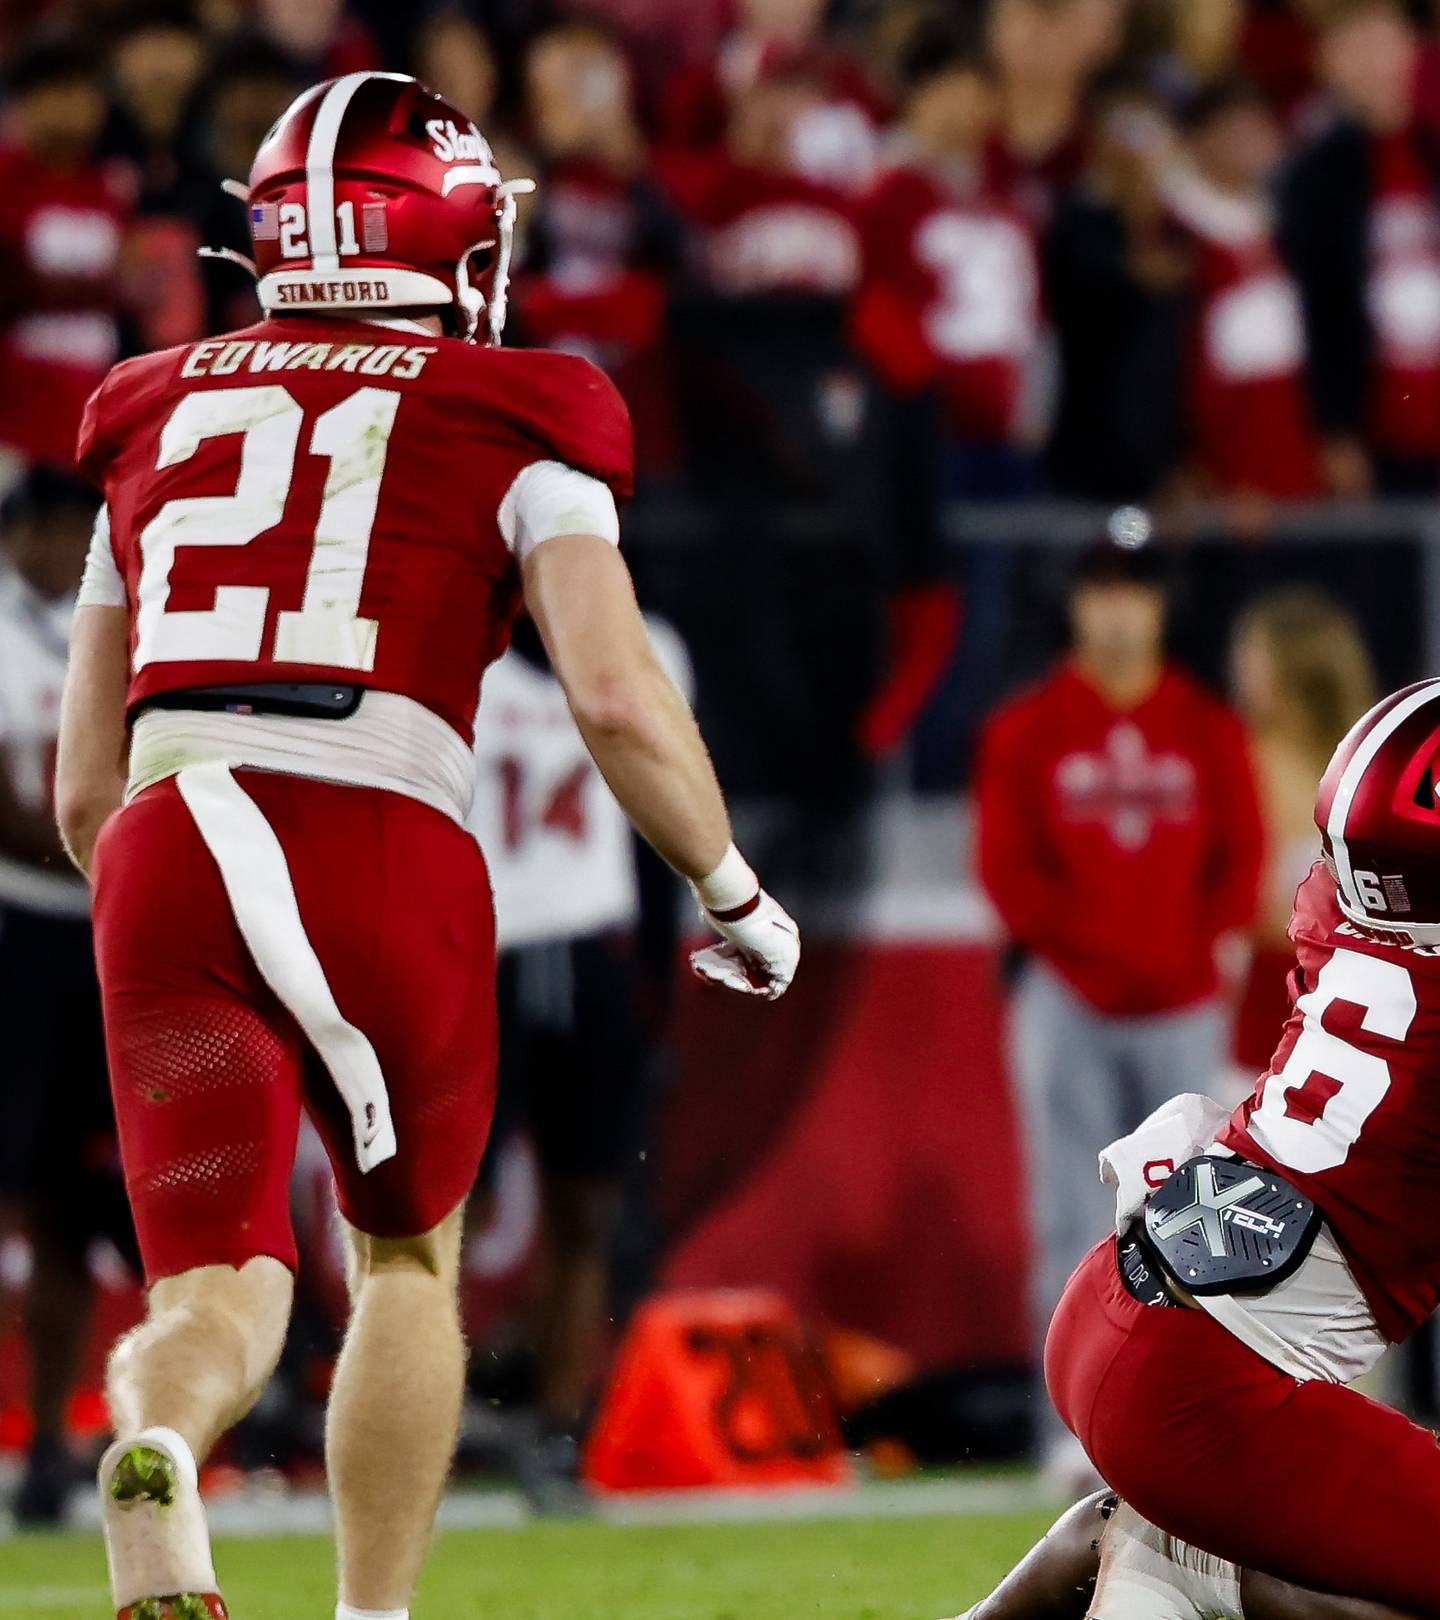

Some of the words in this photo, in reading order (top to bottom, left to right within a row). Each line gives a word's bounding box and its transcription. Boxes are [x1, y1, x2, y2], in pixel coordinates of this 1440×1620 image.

[277, 281, 388, 303] STANFORD
[180, 341, 438, 379] EDWARDS
[132, 384, 402, 673] 21
[1353, 869, 1387, 911] 6
[1246, 947, 1418, 1174] 6
